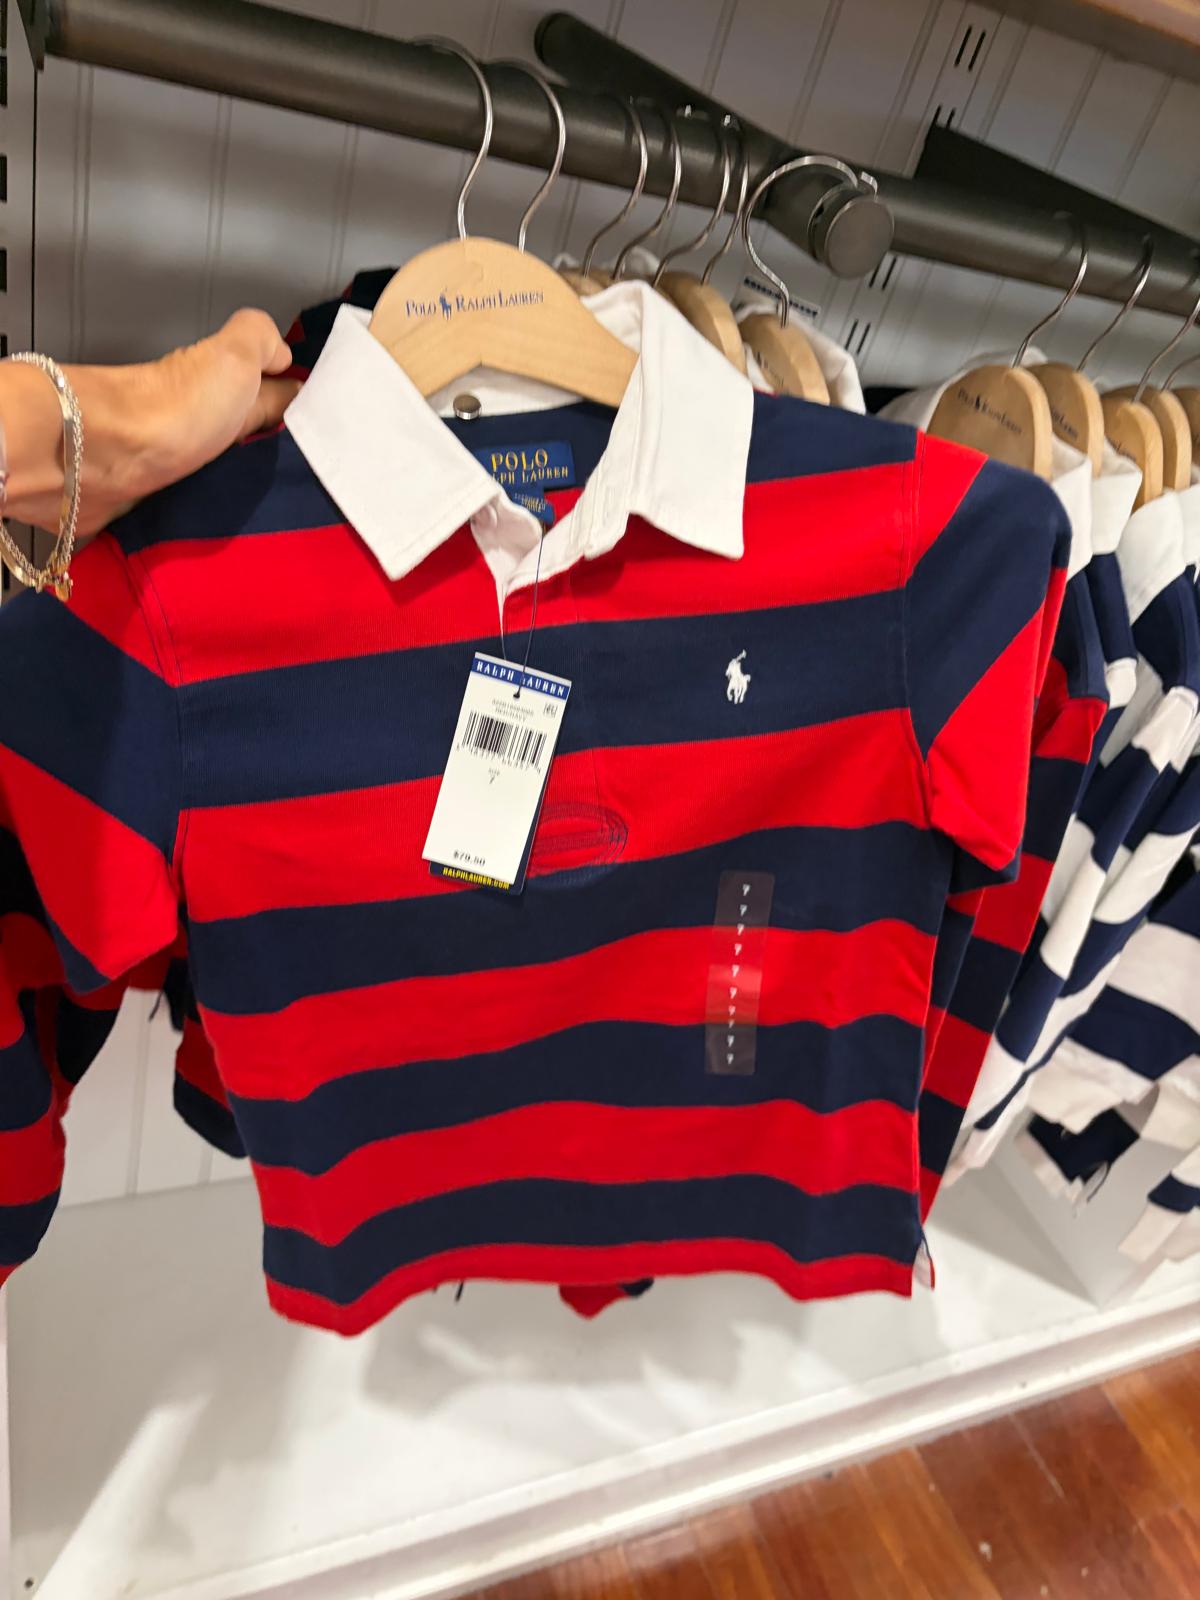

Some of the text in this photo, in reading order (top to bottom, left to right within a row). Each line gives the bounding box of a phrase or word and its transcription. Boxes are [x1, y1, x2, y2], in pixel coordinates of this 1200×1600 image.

[405, 289, 544, 318] POLO RALPH LAUREN
[491, 448, 548, 473] POLO
[522, 466, 568, 483] LAUREN
[476, 660, 515, 682] RALPH
[743, 884, 750, 896] 7
[740, 904, 747, 917] 7
[737, 924, 744, 936] 7
[735, 943, 742, 956] 7
[732, 965, 740, 977] 7
